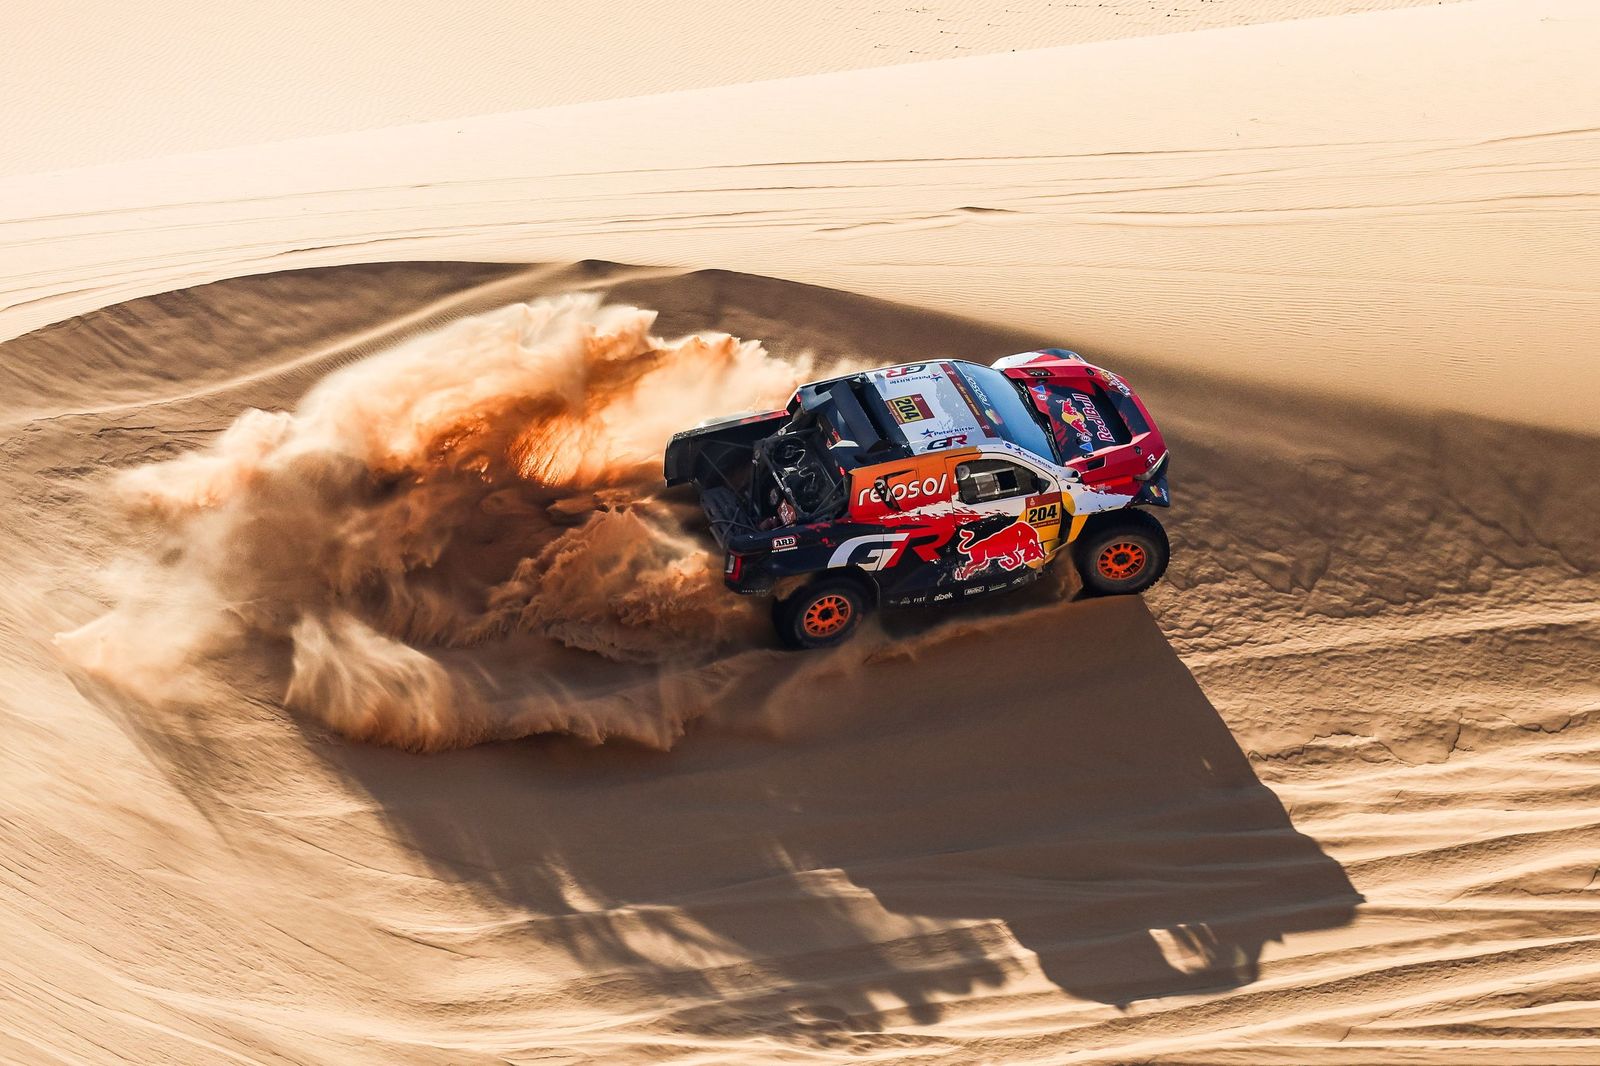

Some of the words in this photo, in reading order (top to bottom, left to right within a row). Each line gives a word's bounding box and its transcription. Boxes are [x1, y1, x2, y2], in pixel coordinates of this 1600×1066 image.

[886, 365, 926, 378] GR
[895, 399, 920, 419] 204
[927, 434, 967, 450] GR
[1029, 504, 1057, 523] 204
[775, 538, 794, 546] ARB
[827, 526, 957, 571] GR
